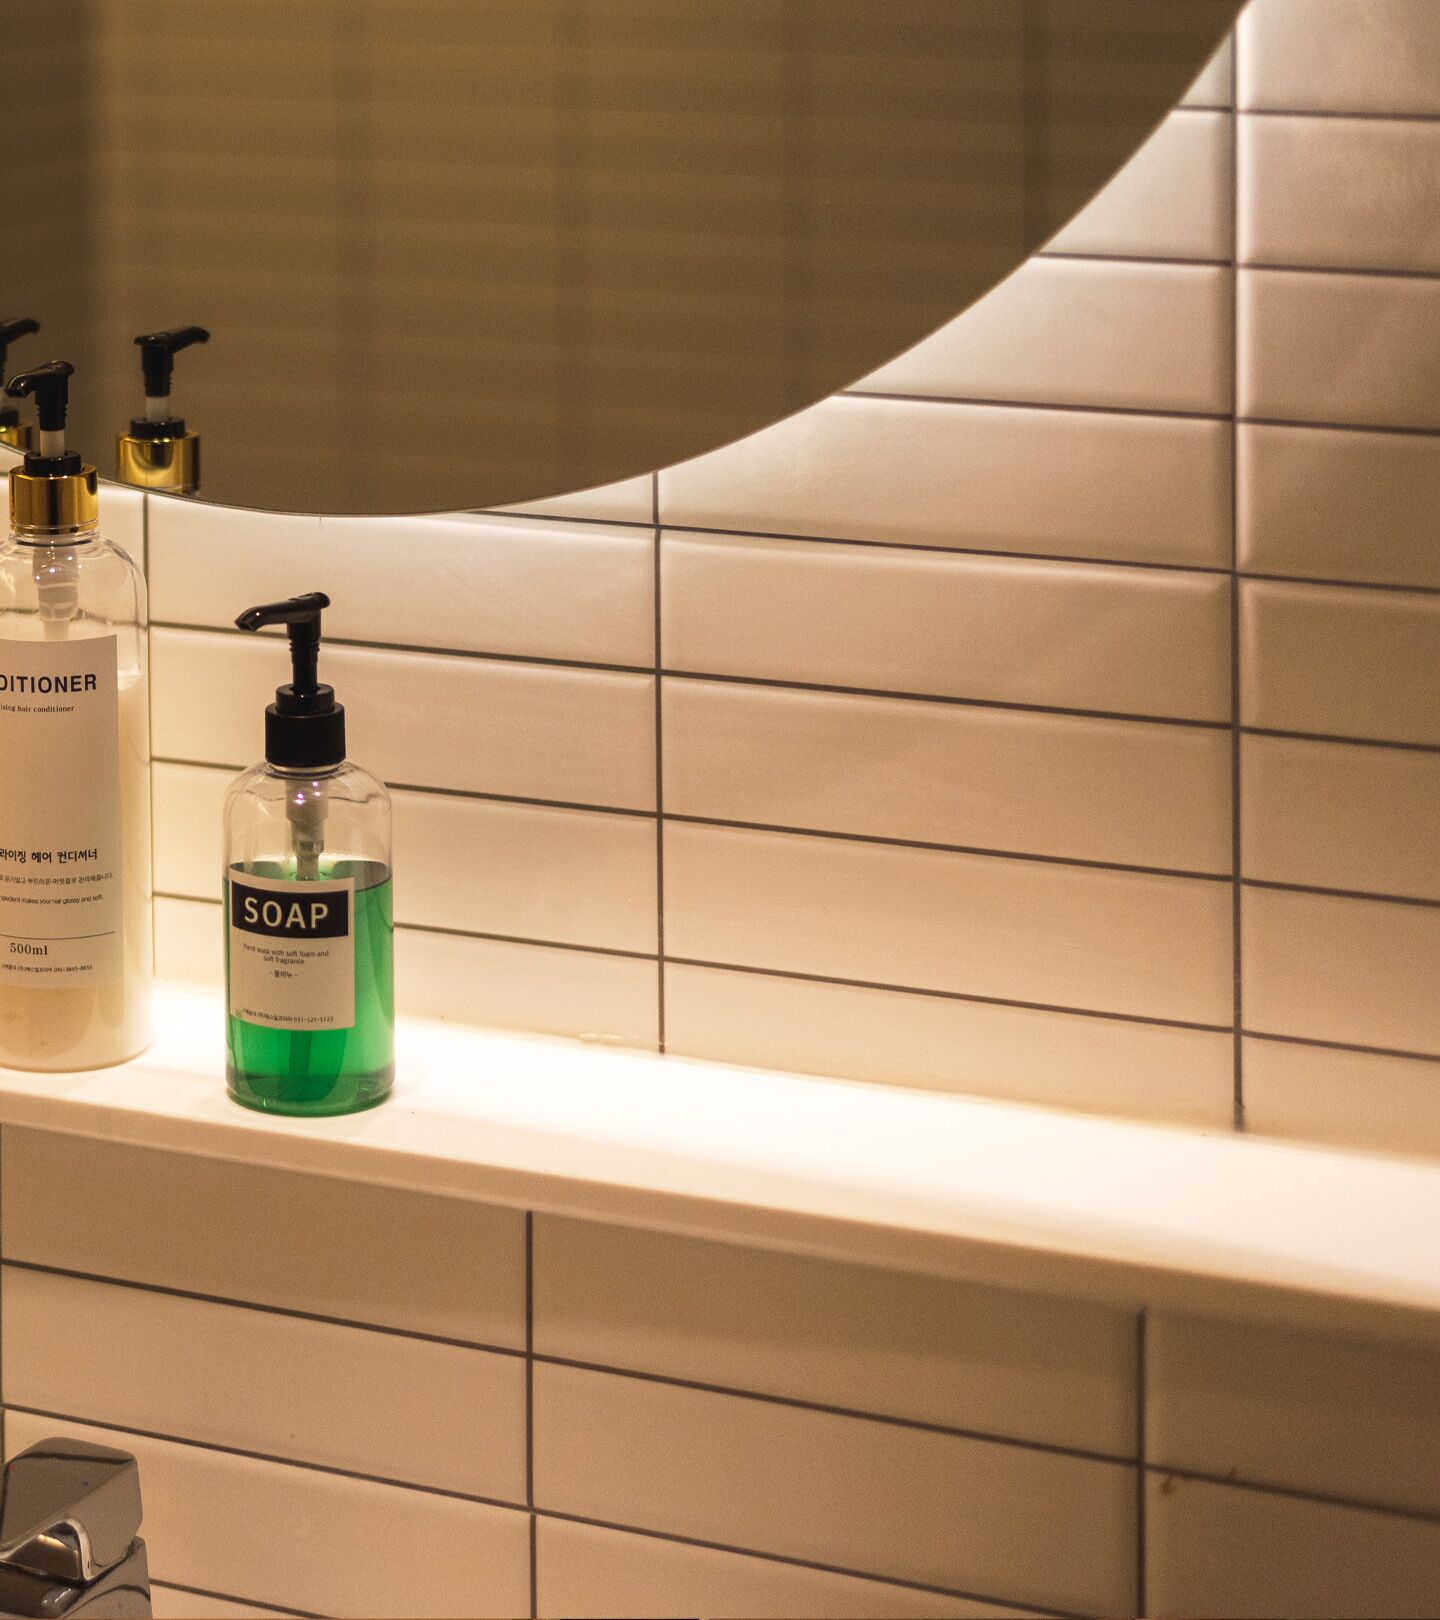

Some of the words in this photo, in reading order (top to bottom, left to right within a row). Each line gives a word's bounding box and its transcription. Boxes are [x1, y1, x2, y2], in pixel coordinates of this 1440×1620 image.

[33, 705, 75, 713] conditioner
[31, 851, 52, 863] 헤어
[57, 848, 98, 863] 컨디셔너
[244, 896, 329, 929] SOAP
[10, 942, 48, 956] 500ml
[276, 956, 305, 965] fragrance
